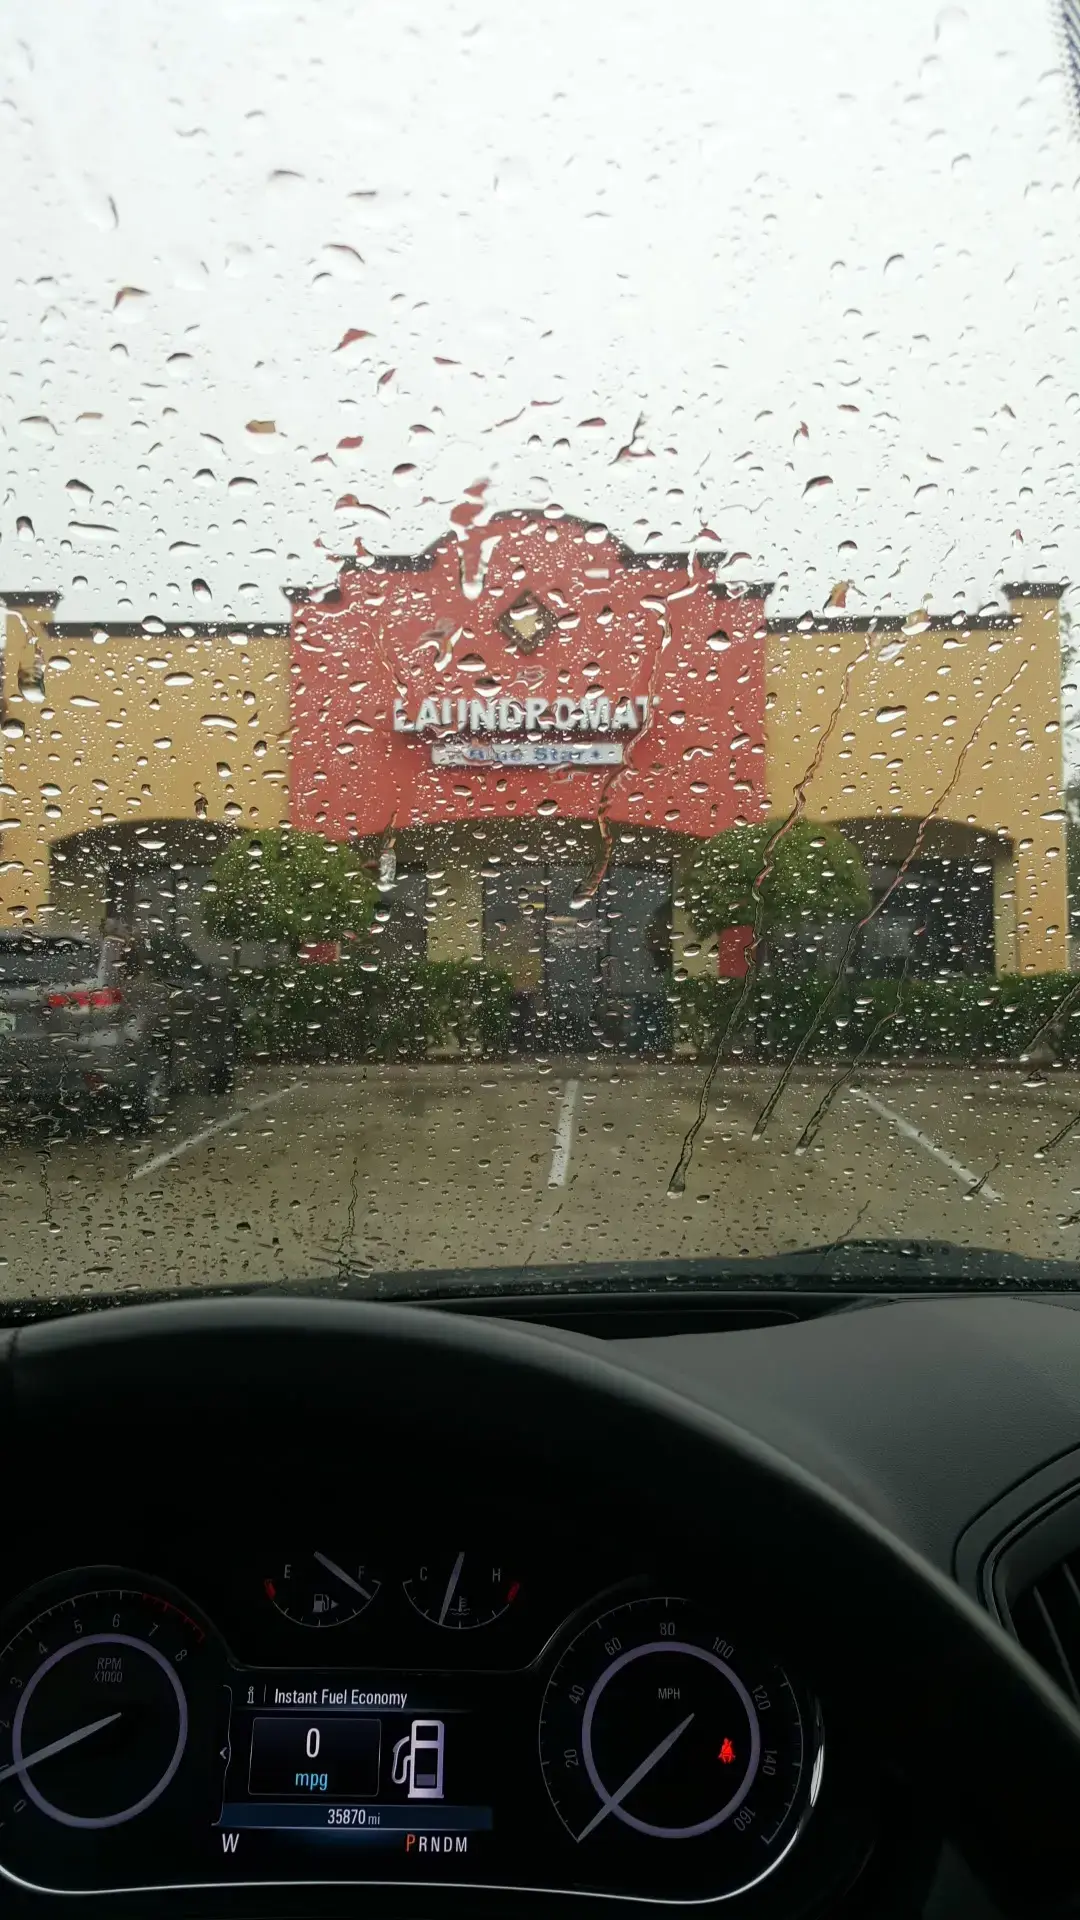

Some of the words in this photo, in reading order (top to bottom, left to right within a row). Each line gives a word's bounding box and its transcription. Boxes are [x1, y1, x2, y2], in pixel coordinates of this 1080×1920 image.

[393, 696, 660, 731] LAUNDROMAT
[284, 1564, 291, 1580] E
[357, 1565, 365, 1580] F
[419, 1566, 428, 1581] C
[492, 1568, 501, 1583] H
[73, 1619, 83, 1634] 5
[112, 1613, 121, 1628] 6
[659, 1621, 676, 1636] 80
[148, 1622, 160, 1637] 7
[38, 1641, 48, 1654] 4
[604, 1637, 623, 1656] 60
[712, 1636, 736, 1660] 100
[97, 1657, 122, 1670] RPM
[175, 1649, 188, 1662] 8
[10, 1677, 24, 1688] 3
[274, 1690, 318, 1705] Instant
[321, 1689, 347, 1705] Fuel
[351, 1689, 408, 1709] Economy
[568, 1684, 585, 1704] 40
[657, 1687, 681, 1700] MPH
[752, 1684, 772, 1711] 120
[305, 1728, 321, 1758] 0
[563, 1748, 579, 1768] 20
[761, 1748, 778, 1777] 140
[295, 1772, 329, 1791] mpg
[13, 1799, 27, 1813] 0
[327, 1809, 366, 1825] 35870
[368, 1812, 381, 1826] mi
[732, 1806, 756, 1831] 160
[221, 1833, 240, 1853] W
